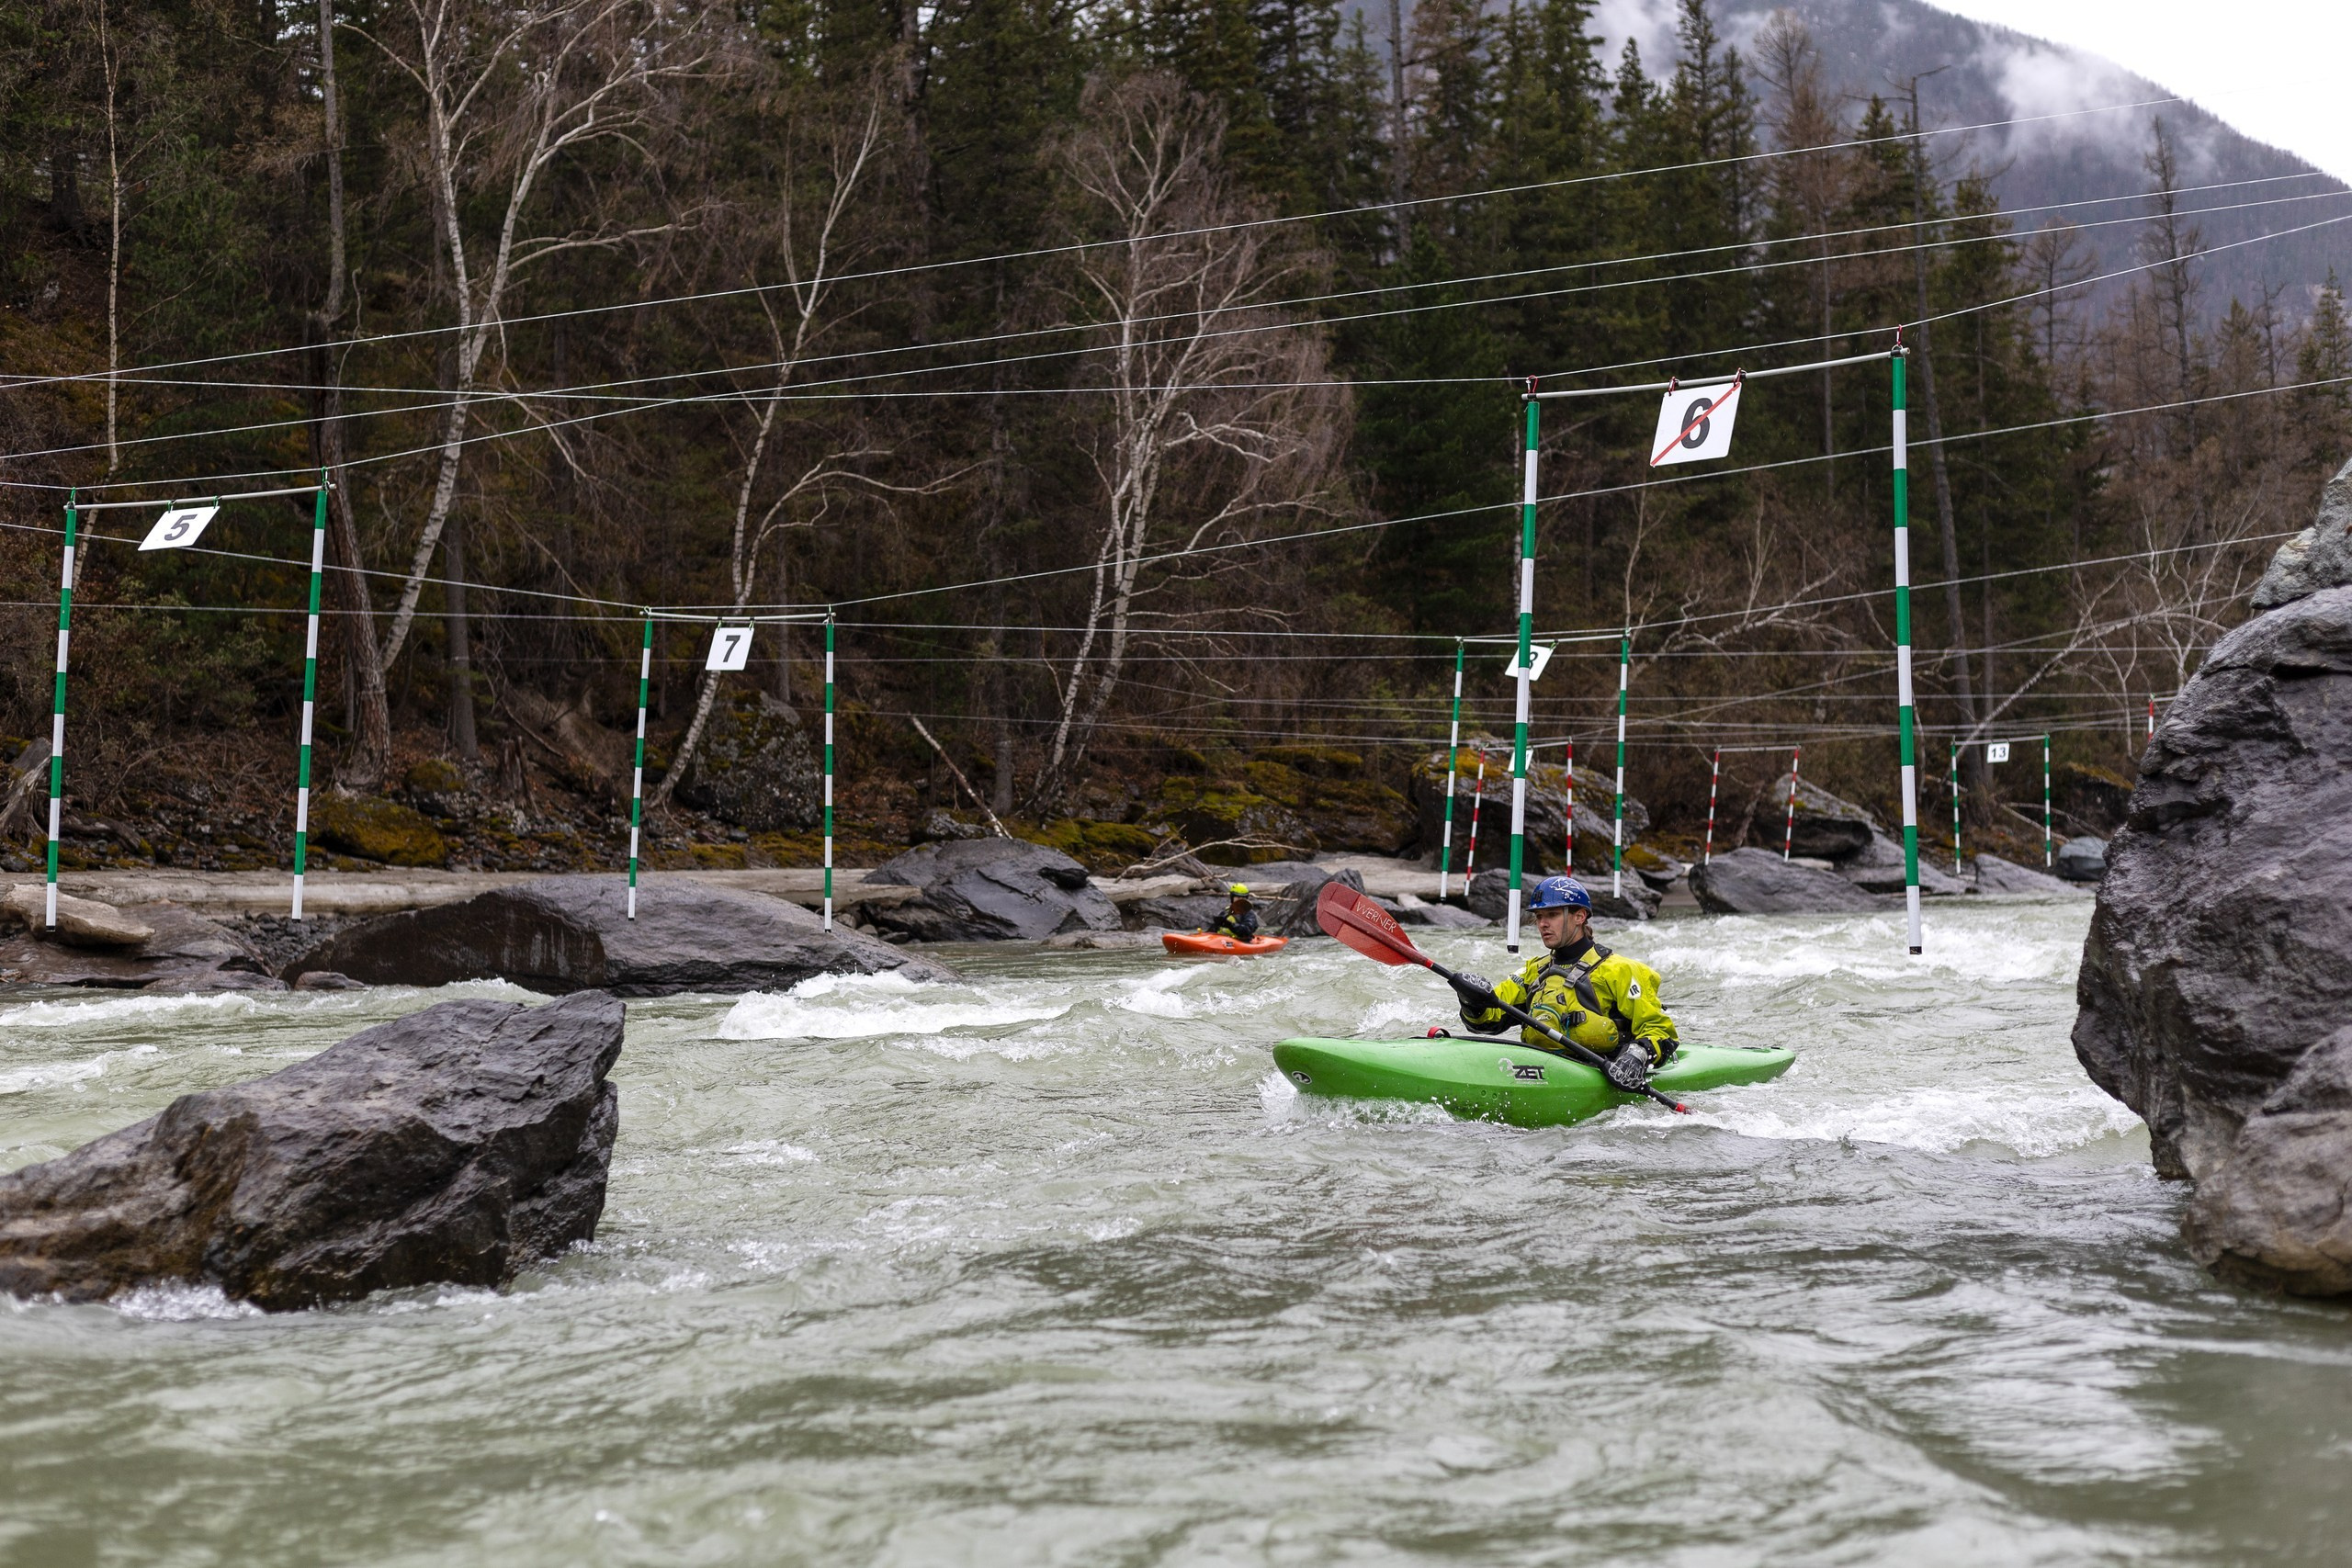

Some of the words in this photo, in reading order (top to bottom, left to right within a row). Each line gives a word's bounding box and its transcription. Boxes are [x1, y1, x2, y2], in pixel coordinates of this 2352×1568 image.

[1680, 397, 1713, 449] 6
[164, 513, 198, 541] 5
[722, 635, 741, 662] 7
[1991, 747, 2007, 759] 13
[1356, 901, 1396, 933] WERNER
[1629, 984, 1640, 997] IR
[1512, 1065, 1545, 1080] ZET
